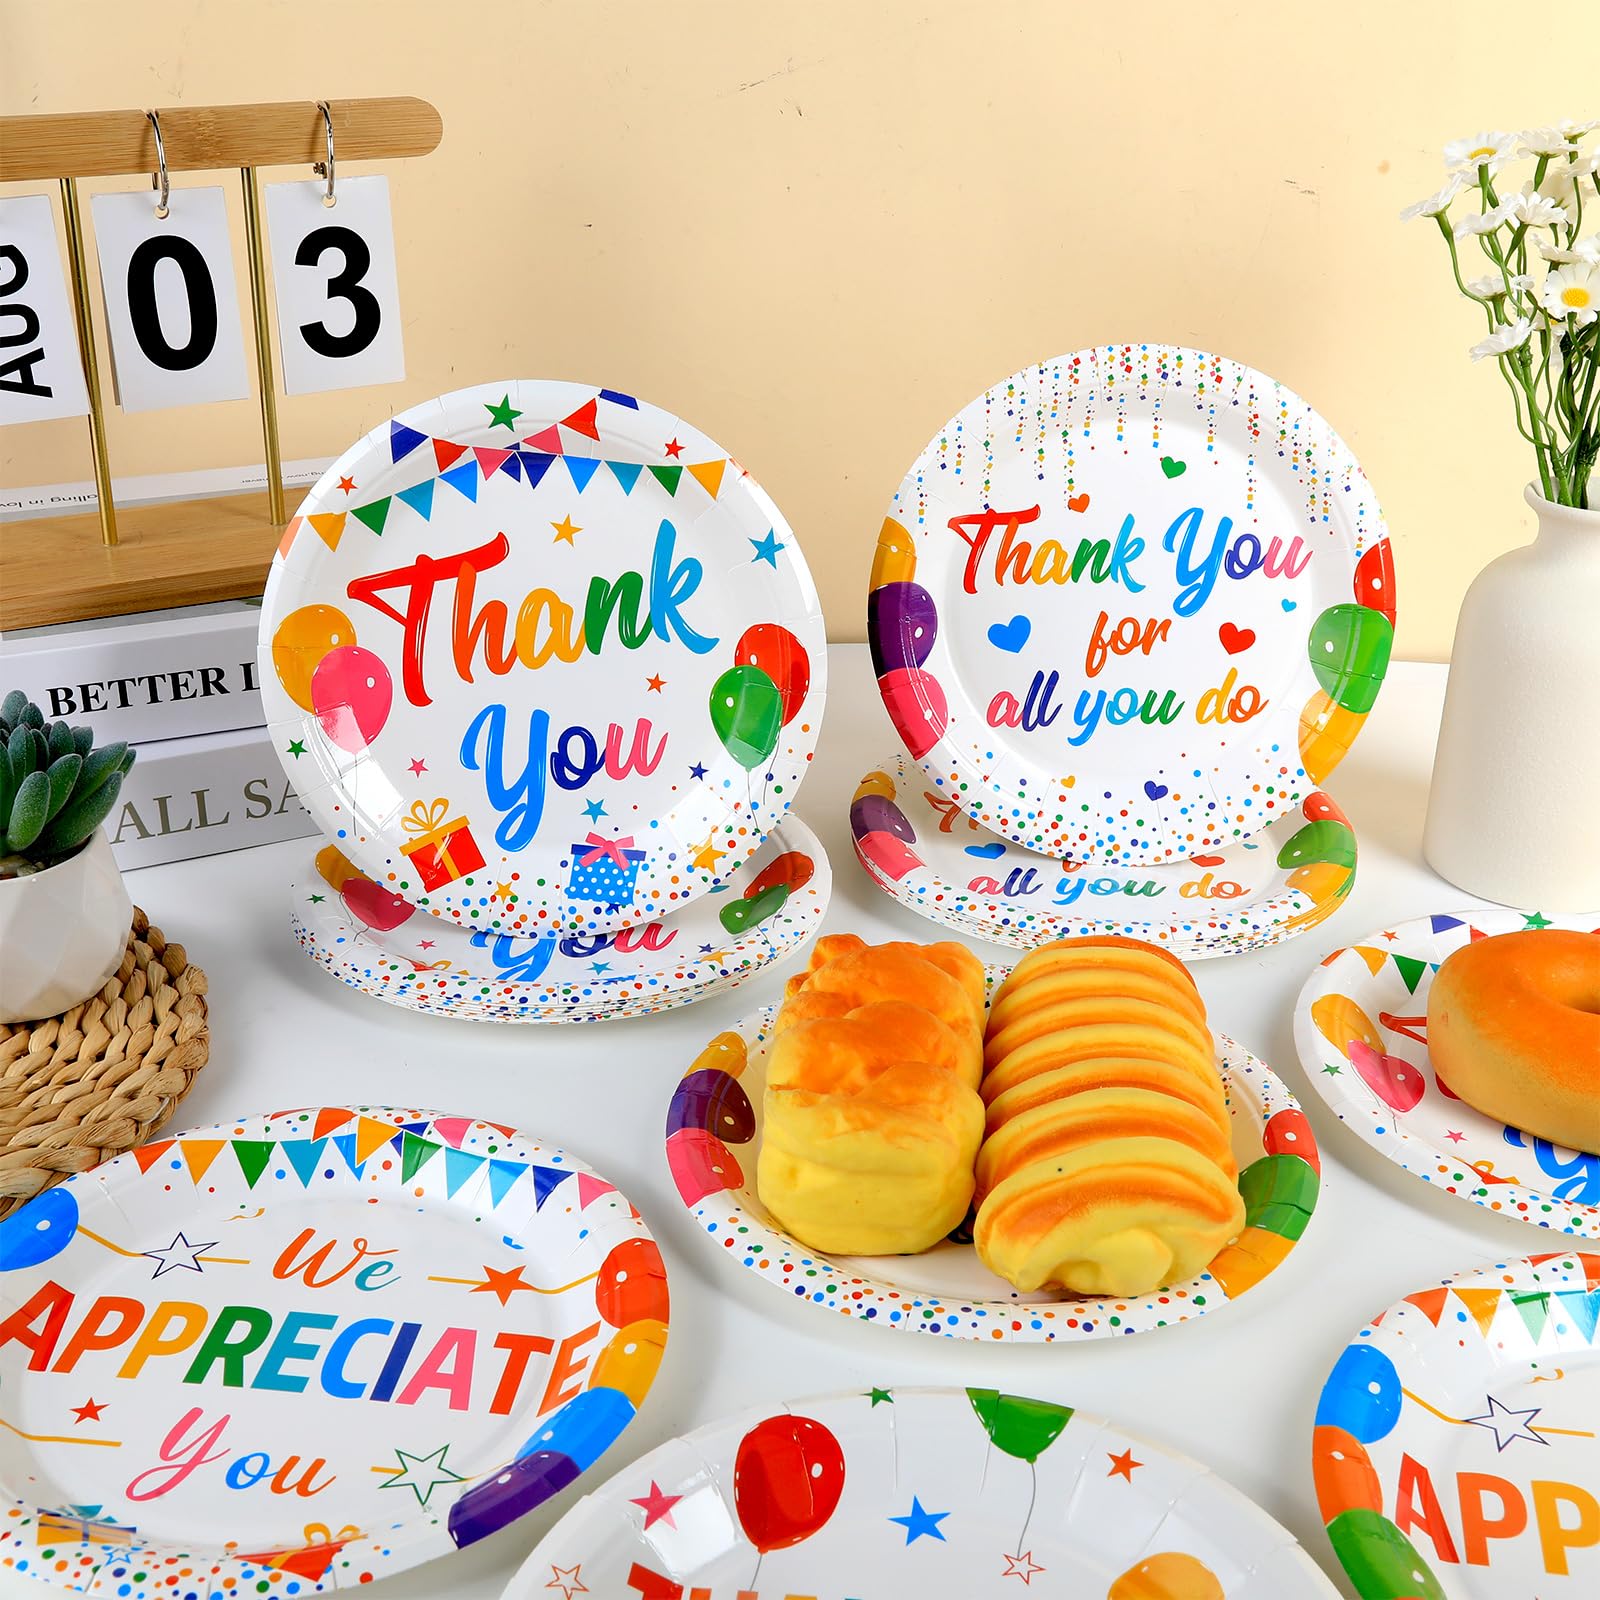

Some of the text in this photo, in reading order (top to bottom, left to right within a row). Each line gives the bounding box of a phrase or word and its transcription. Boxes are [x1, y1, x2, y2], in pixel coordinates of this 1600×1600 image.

[127, 234, 218, 371] 0
[295, 225, 382, 358] 3
[50, 494, 98, 502] alling
[948, 504, 1314, 618] Thank You
[347, 518, 720, 707] Thank
[1085, 611, 1170, 678] for
[46, 666, 231, 718] BETTER
[986, 667, 1269, 746] all you do
[109, 788, 230, 845] ALL
[459, 704, 669, 852] You
[967, 868, 1251, 905] all you do
[272, 1227, 402, 1292] We
[0, 1280, 602, 1417] APPRECIATE
[125, 1407, 337, 1502] You
[1395, 1452, 1600, 1576] APP
